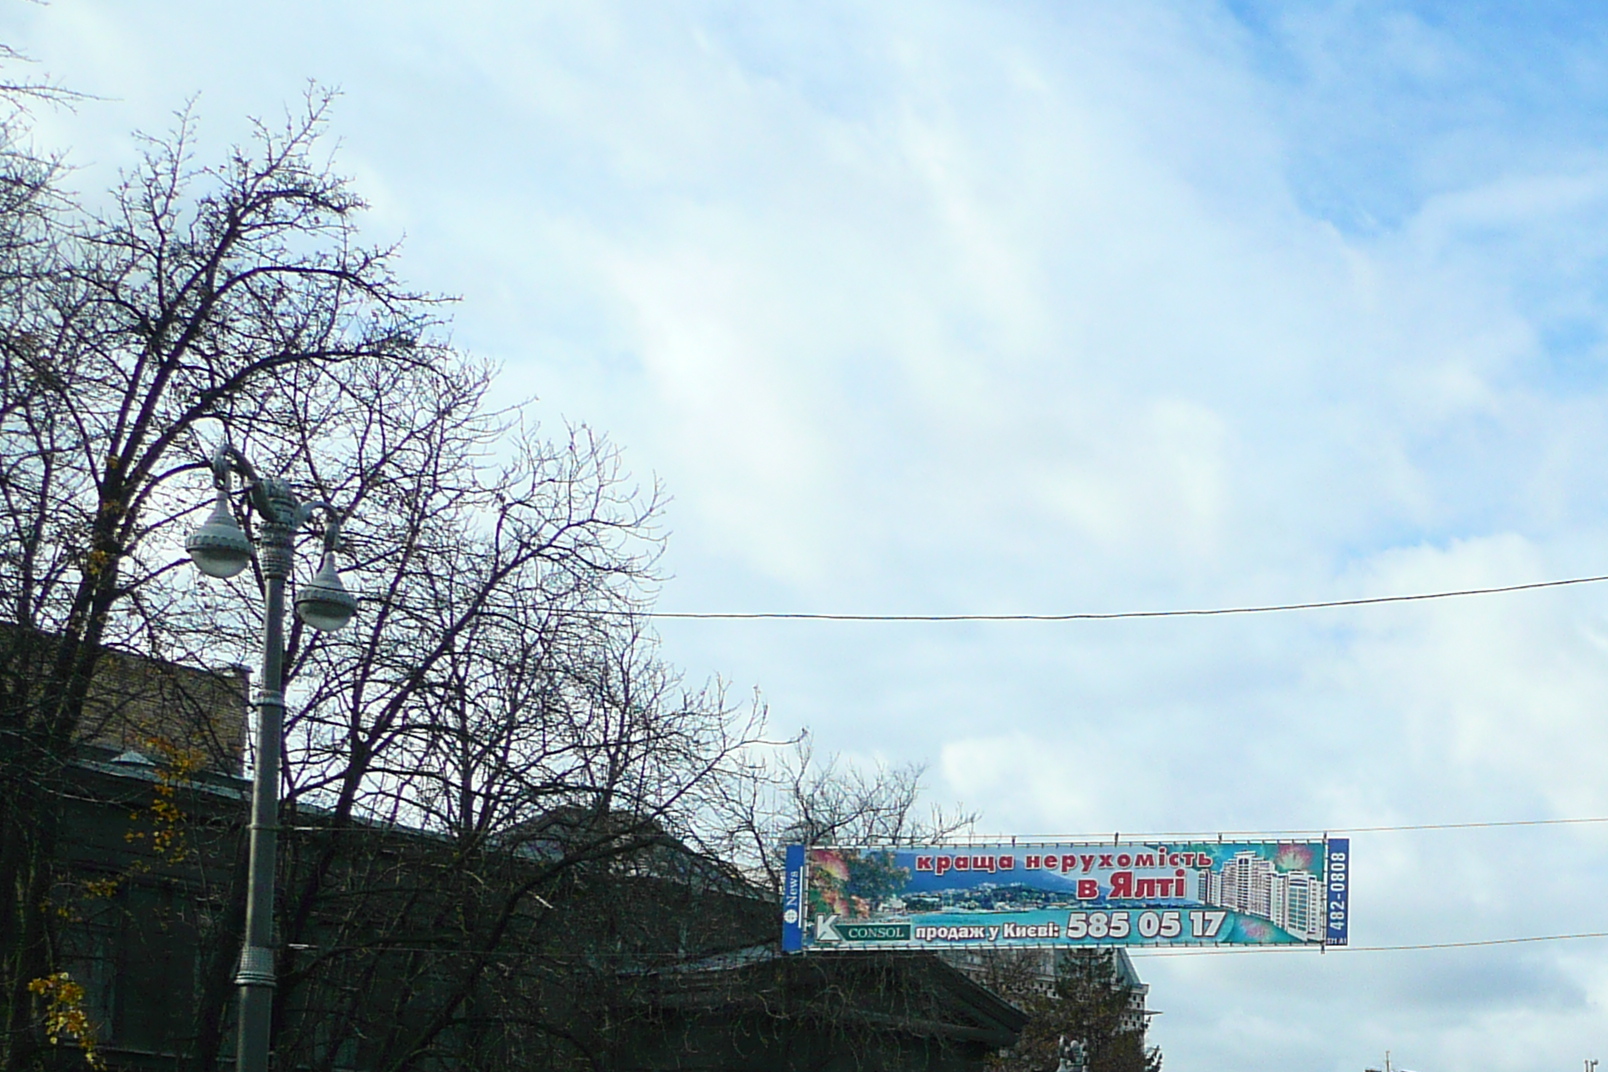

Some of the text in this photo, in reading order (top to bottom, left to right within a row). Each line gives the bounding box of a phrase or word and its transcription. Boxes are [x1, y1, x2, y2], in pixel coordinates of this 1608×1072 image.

[916, 848, 1213, 875] краща нерухомість
[788, 871, 799, 906] News
[1076, 870, 1186, 900] в Ялті
[1329, 852, 1346, 931] 482-0808
[848, 926, 905, 939] CONSOL
[915, 922, 1060, 942] продаж у Києві:
[1067, 912, 1226, 939] 585 05 17
